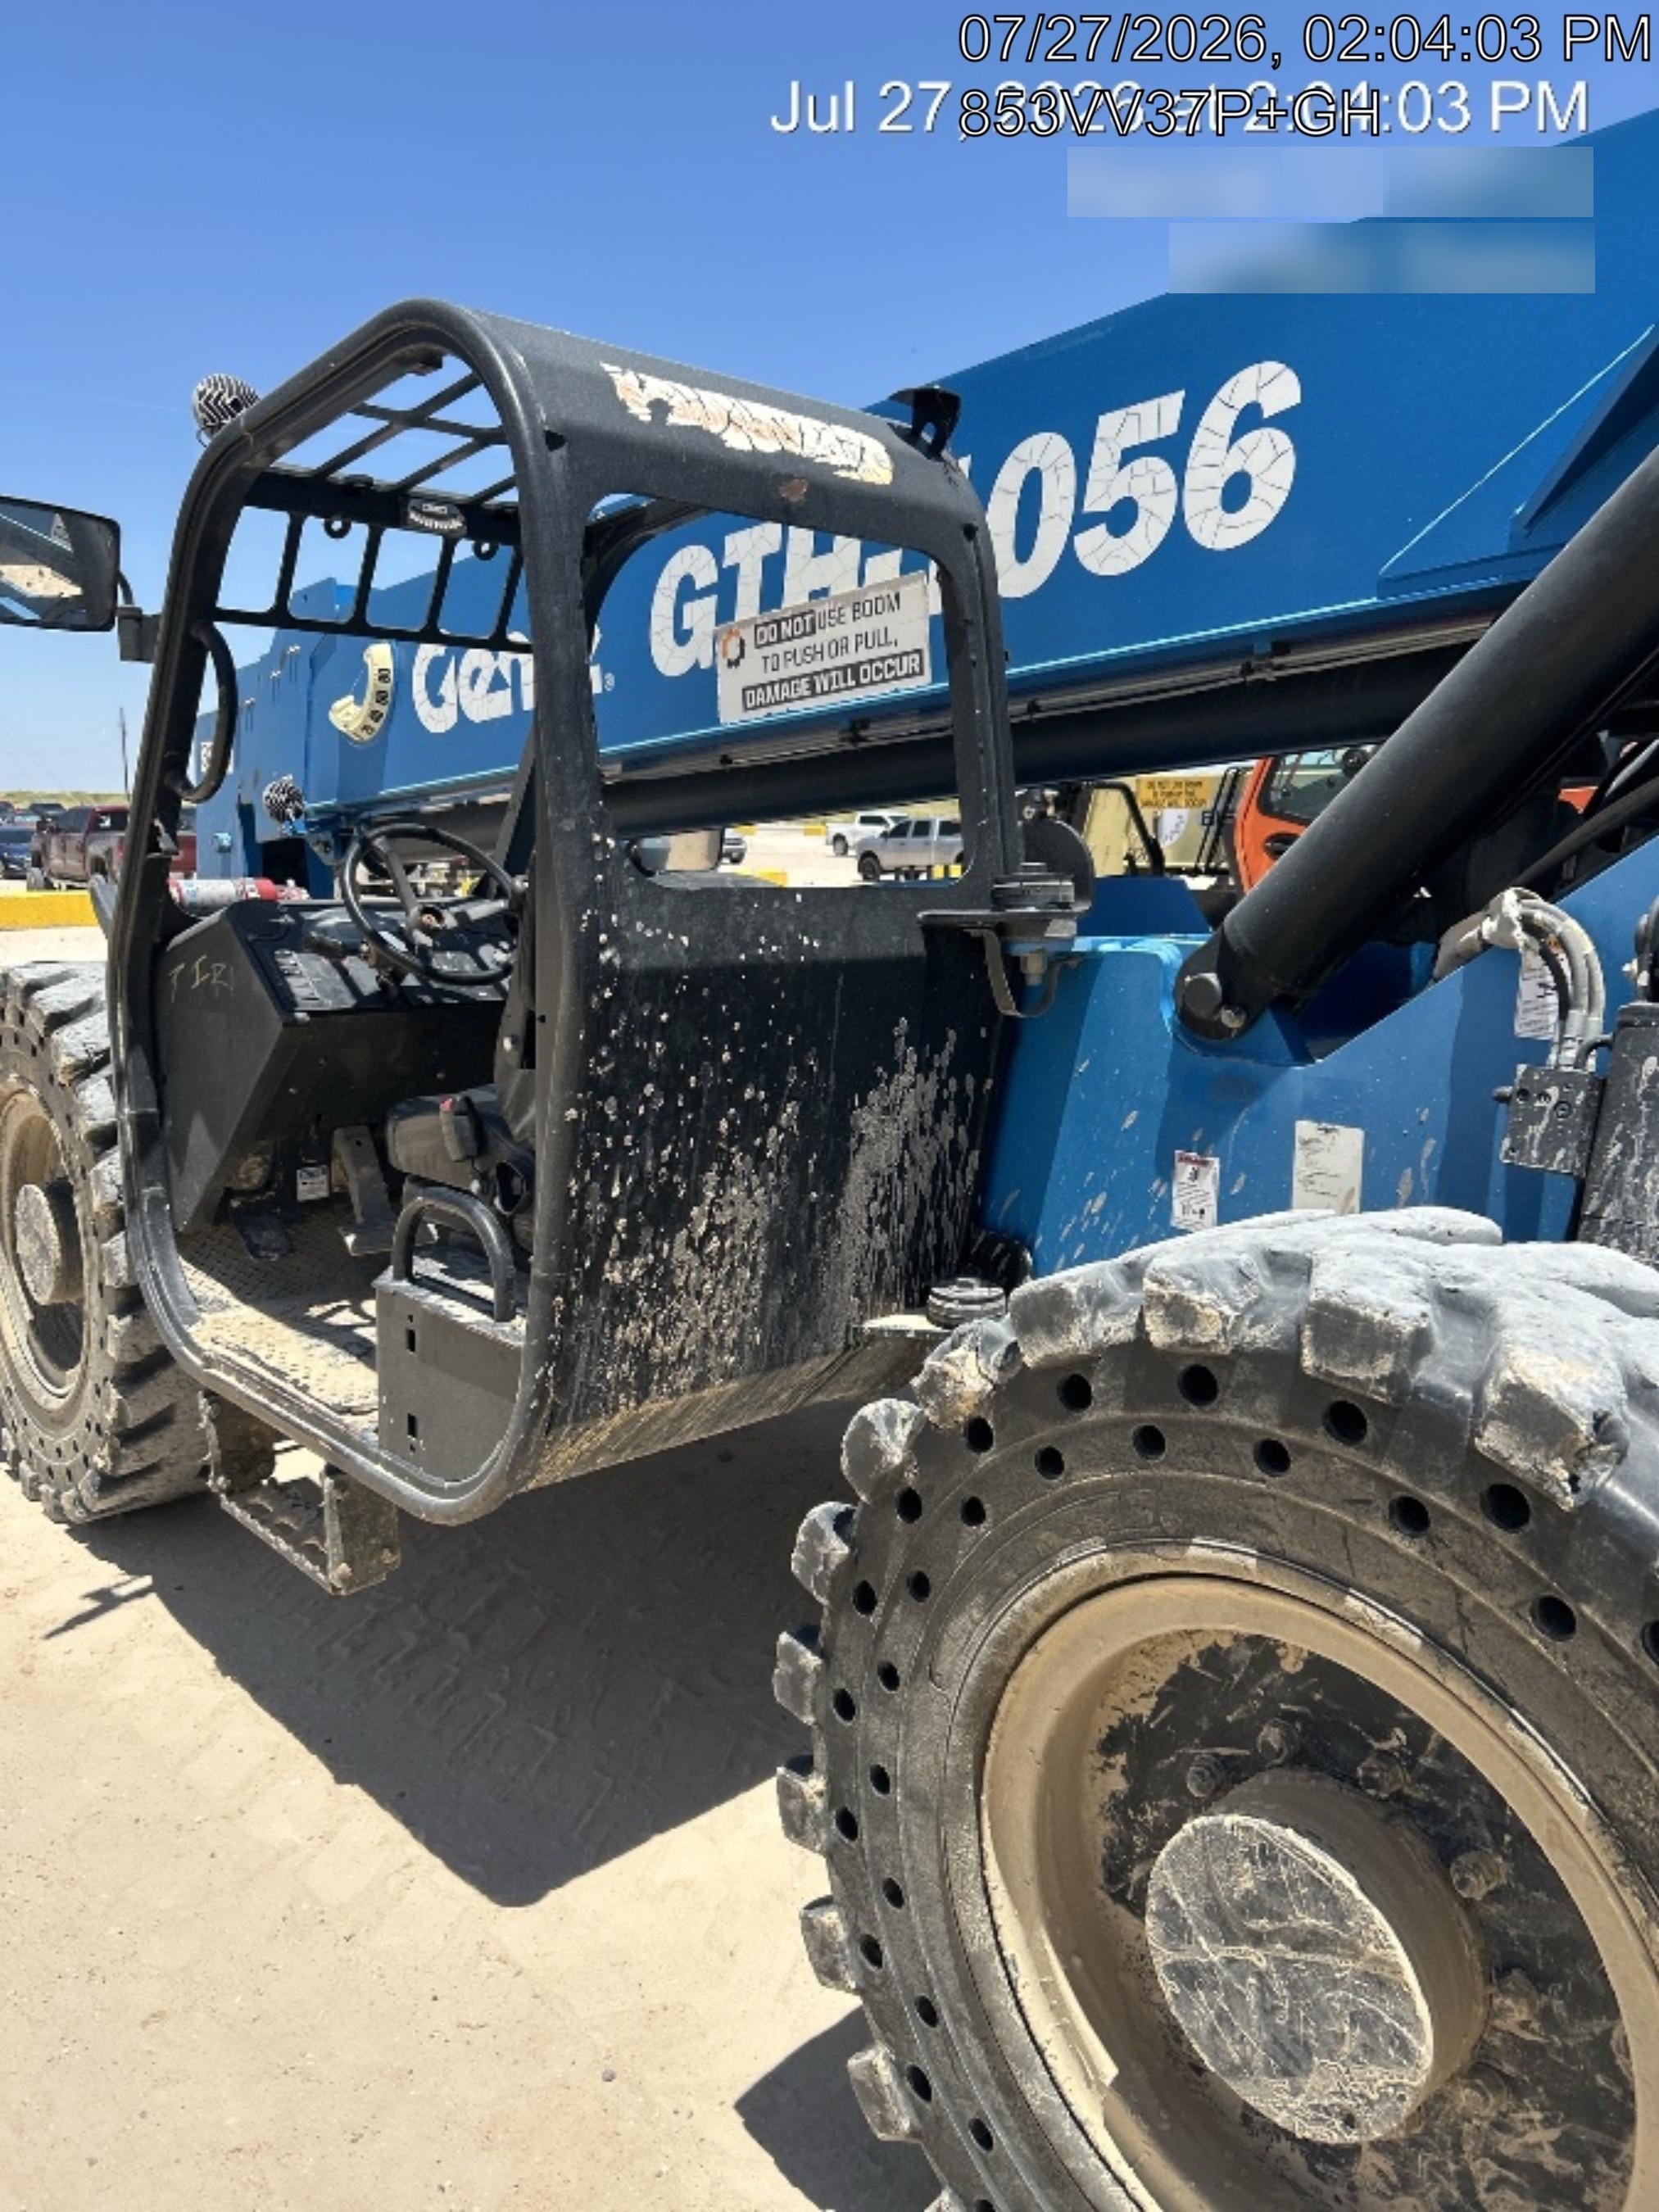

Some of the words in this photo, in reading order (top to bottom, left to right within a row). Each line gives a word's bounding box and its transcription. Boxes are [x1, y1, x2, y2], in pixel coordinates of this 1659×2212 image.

[650, 360, 1302, 678] GTH-056
[756, 623, 778, 646] DO
[781, 614, 814, 640] NOT
[817, 606, 847, 631] USE
[852, 592, 901, 623] BOOM
[745, 677, 812, 710] DAMAGE
[814, 667, 856, 696] WILL
[860, 652, 921, 683] OCCUR
[762, 653, 779, 674] TO
[783, 644, 823, 668] PUSH
[828, 636, 849, 659] OR
